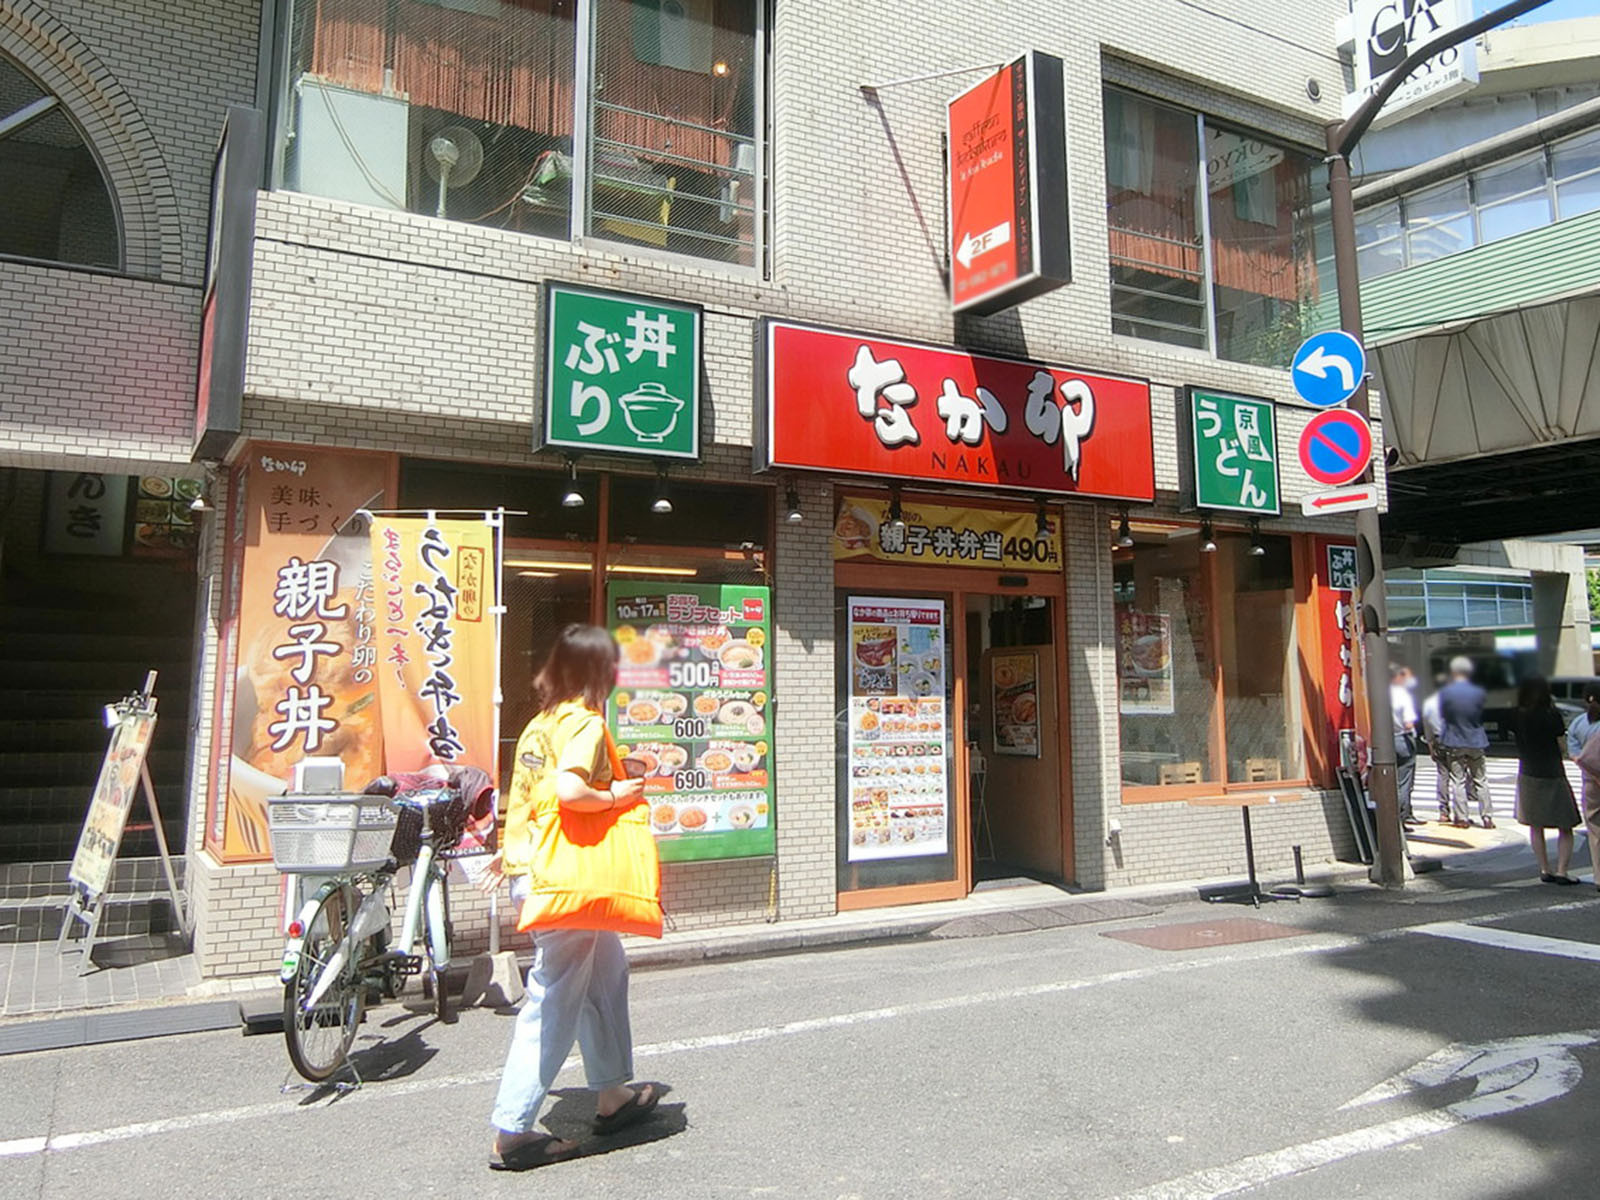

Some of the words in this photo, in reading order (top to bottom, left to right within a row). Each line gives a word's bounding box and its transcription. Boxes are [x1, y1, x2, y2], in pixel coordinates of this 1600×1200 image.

[1363, 47, 1458, 96] TYO
[970, 232, 994, 256] 2F
[848, 344, 1096, 484] なか卯
[931, 450, 1032, 479] NAKAU
[1197, 399, 1267, 507] うどん
[261, 456, 307, 477] なか卯
[270, 511, 363, 535] 手づくり
[879, 521, 1003, 562] 親子丼弁当
[668, 606, 742, 623] ランチセット
[269, 557, 348, 753] 親子丼
[675, 719, 705, 738] 600
[675, 770, 706, 790] 690
